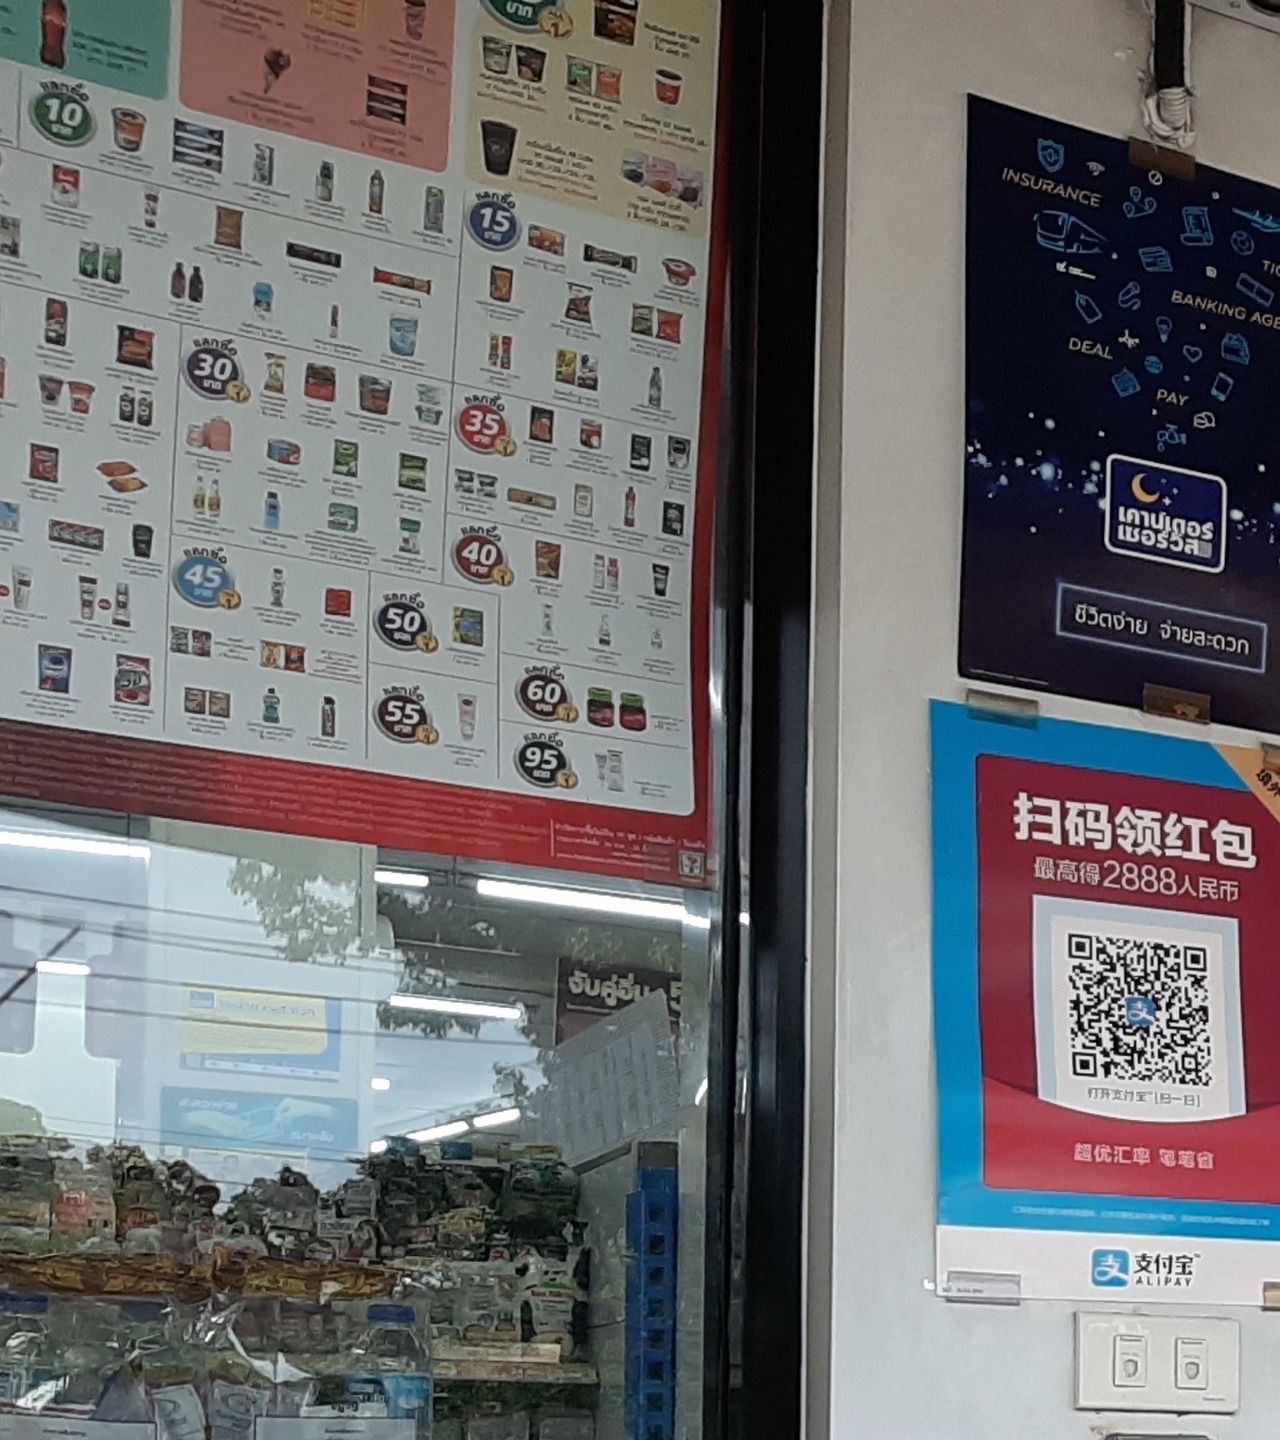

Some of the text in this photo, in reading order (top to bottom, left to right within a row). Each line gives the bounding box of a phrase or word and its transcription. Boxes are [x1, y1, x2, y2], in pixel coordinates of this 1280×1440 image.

[46, 98, 82, 126] 10
[1002, 167, 1103, 208] INSURANCE
[480, 206, 511, 233] 15
[1171, 290, 1246, 321] BANKING
[1069, 337, 1113, 359] DEAL
[193, 353, 233, 380] 30
[1156, 389, 1190, 407] PAY
[464, 410, 500, 435] 35
[461, 541, 497, 566] 40
[184, 564, 222, 587] 45
[385, 608, 420, 632] 50
[1074, 603, 1251, 657] ชีวิตง่าย จ่ายสะดวก
[527, 681, 562, 703] 60
[385, 701, 420, 725] 55
[524, 747, 559, 770] 95
[1012, 791, 1257, 869] 扫码领红包
[1034, 856, 1240, 902] 最高得2888人民币
[1133, 1253, 1195, 1276] 支付宝
[1135, 1275, 1193, 1287] ALIPAY
